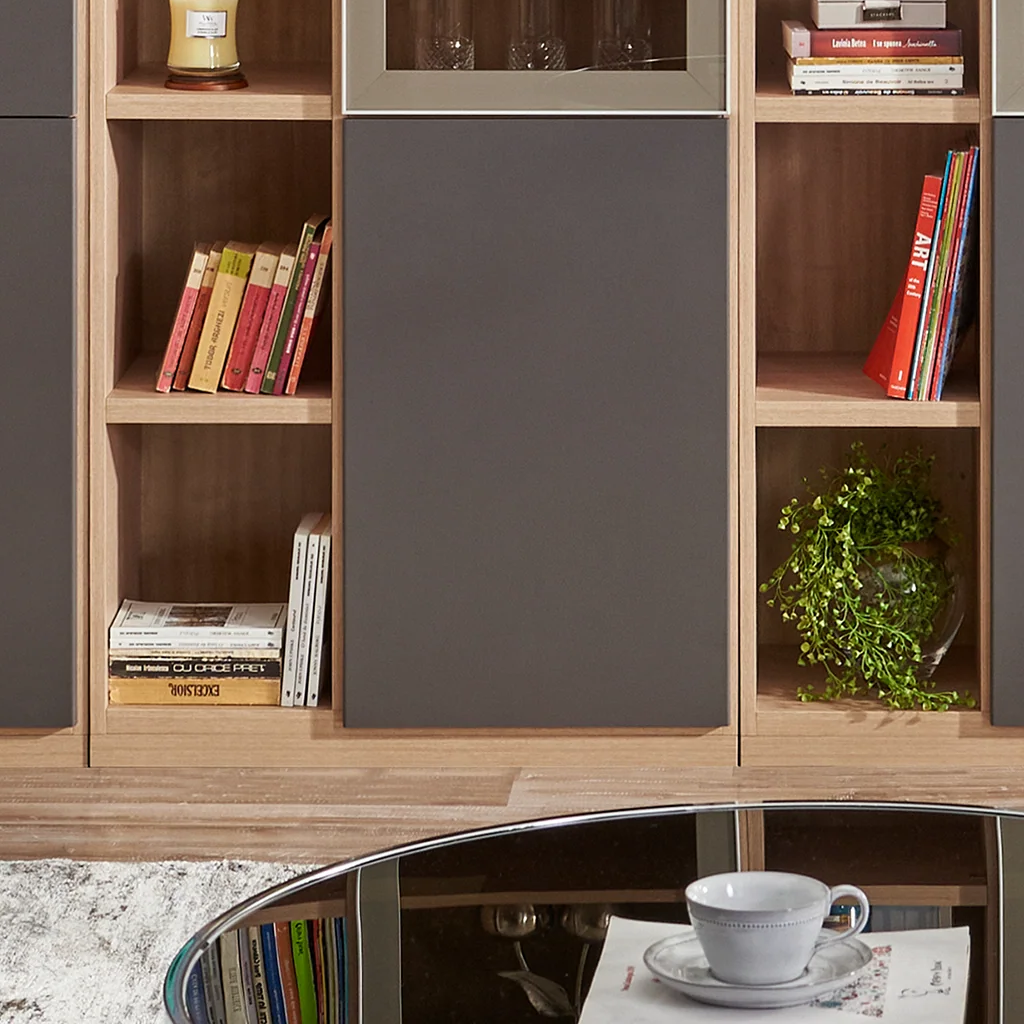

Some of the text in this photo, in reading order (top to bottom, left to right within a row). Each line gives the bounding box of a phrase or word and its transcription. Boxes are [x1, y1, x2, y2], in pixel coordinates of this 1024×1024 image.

[911, 232, 931, 272] ART
[211, 309, 225, 343] ARGHEZI
[168, 683, 220, 696] EXCELSIOR
